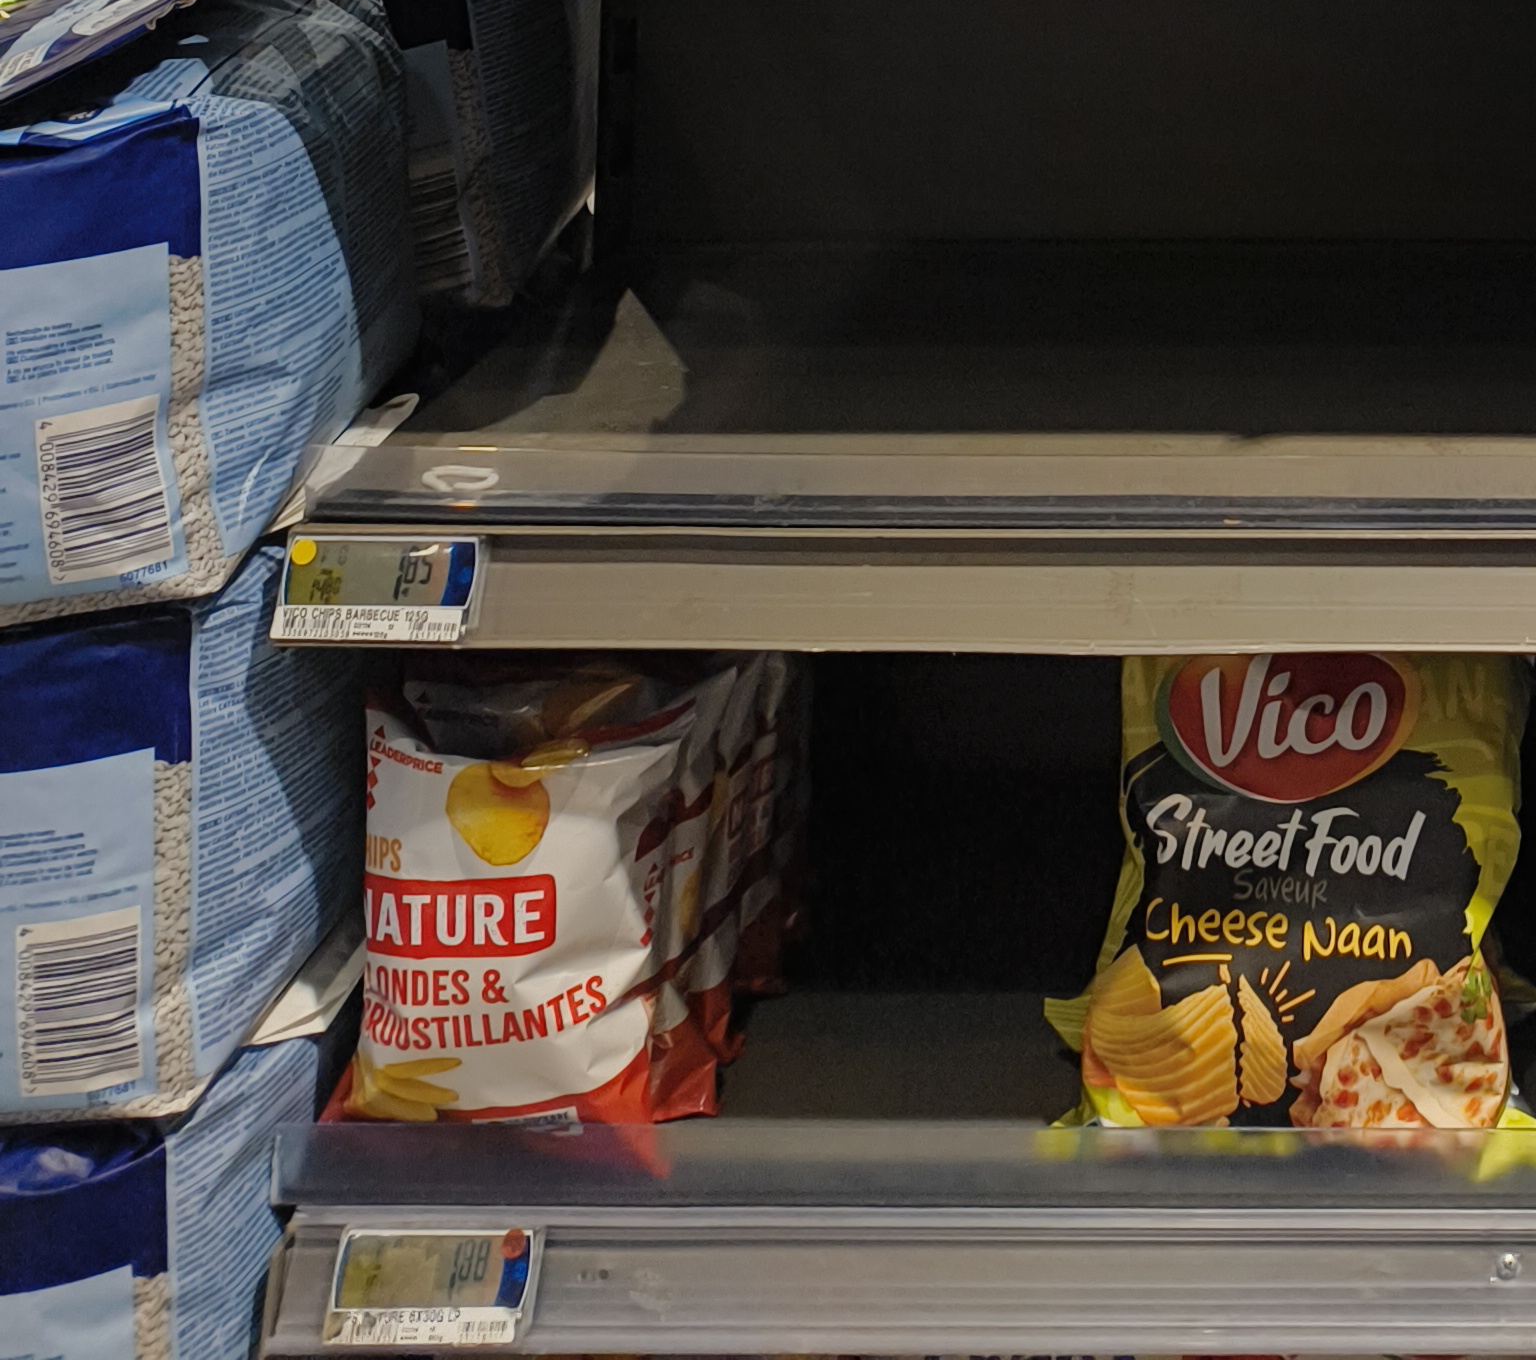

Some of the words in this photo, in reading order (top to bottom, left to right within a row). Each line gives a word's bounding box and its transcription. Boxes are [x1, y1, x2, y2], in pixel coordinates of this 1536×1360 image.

[283, 608, 306, 620] VICO
[311, 608, 341, 620] CHIPS
[345, 609, 400, 621] BARBECUE
[1200, 655, 1388, 768] Vico
[369, 739, 443, 774] LEADERPRICE
[1145, 793, 1308, 872] Street
[1303, 806, 1427, 881] Food
[1232, 868, 1328, 906] Saveur
[1145, 897, 1289, 950] Cheese
[1302, 916, 1412, 961] Naan
[482, 969, 509, 1003] &
[364, 975, 608, 1051] ROUSTILLANTES
